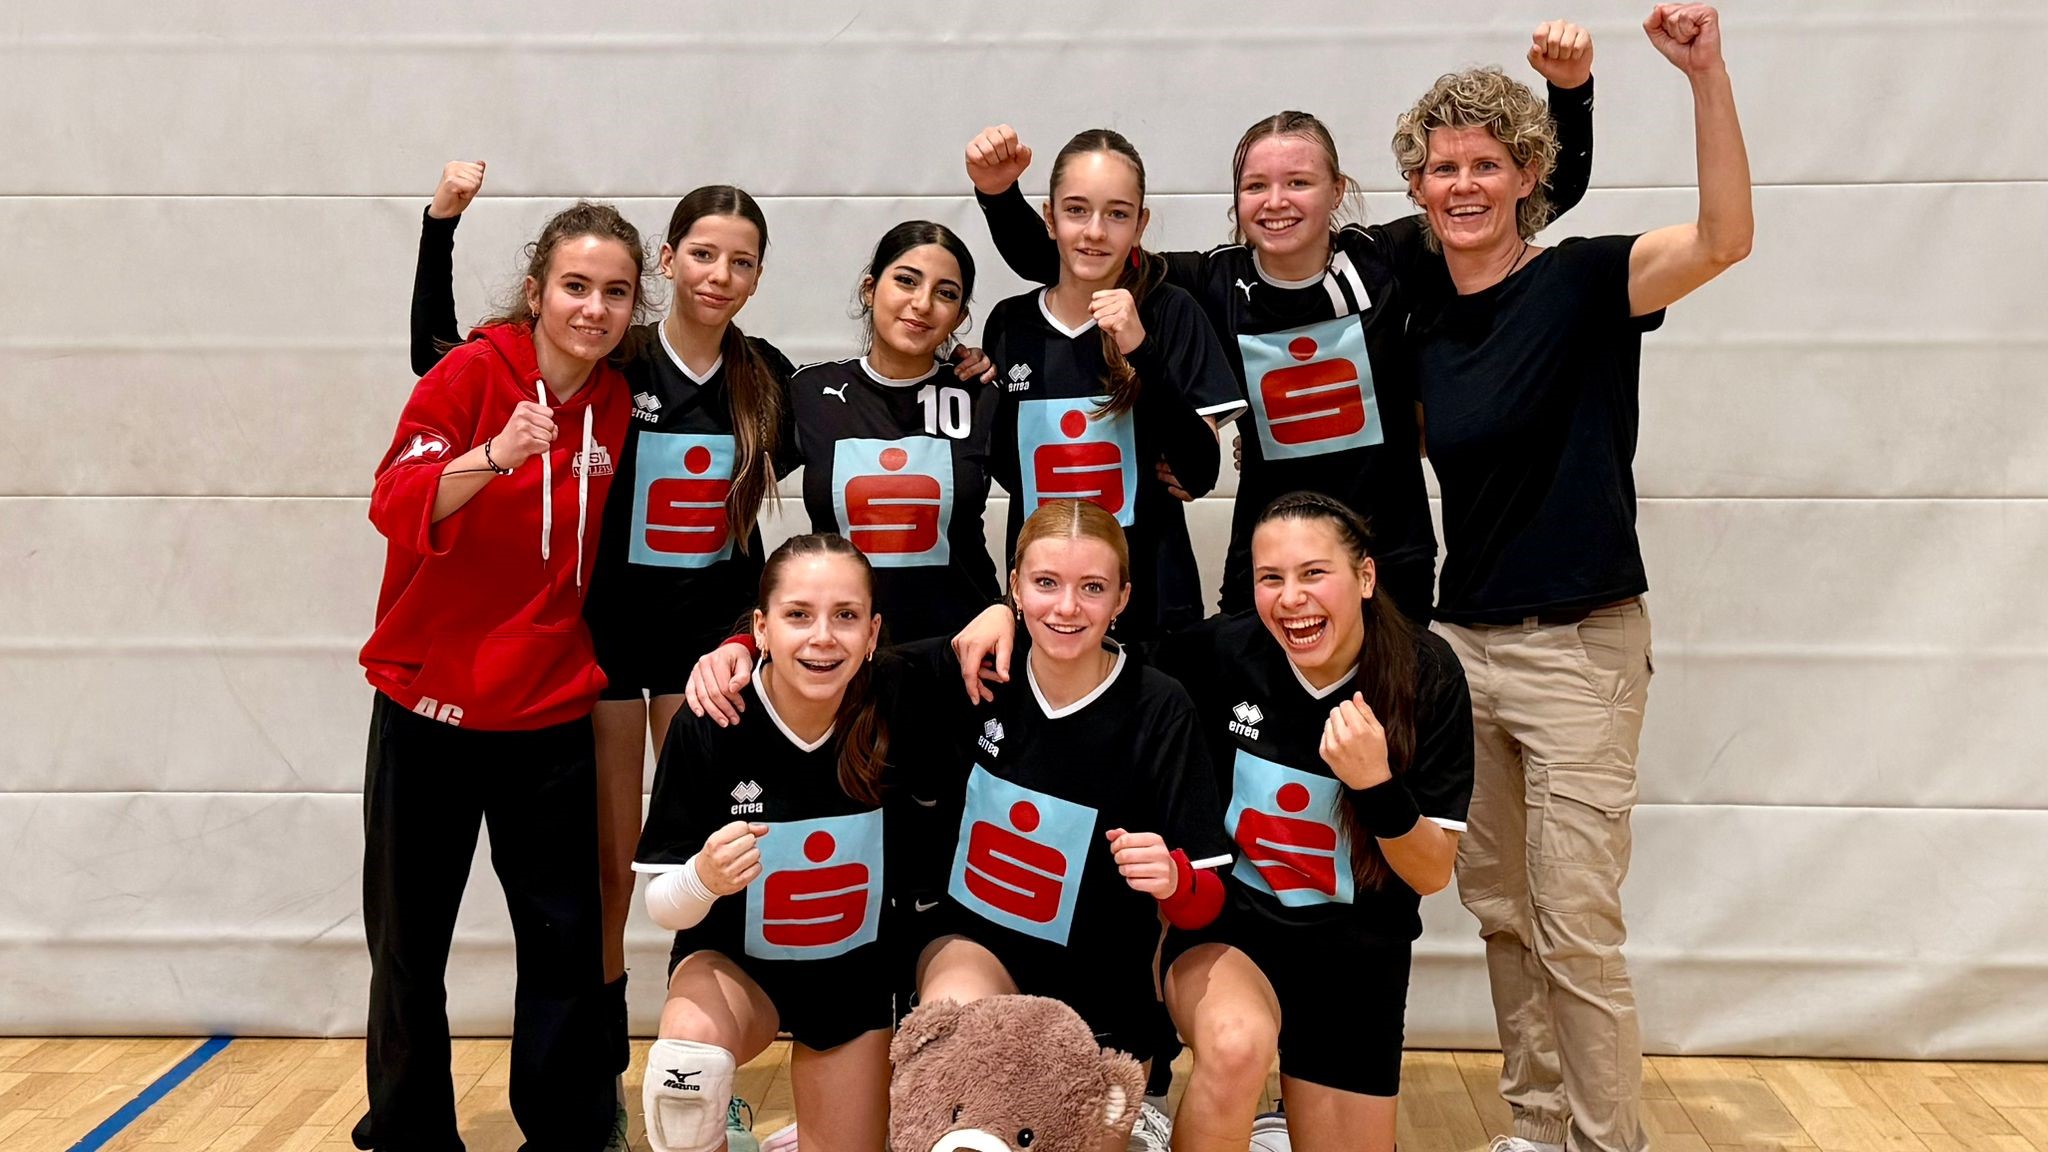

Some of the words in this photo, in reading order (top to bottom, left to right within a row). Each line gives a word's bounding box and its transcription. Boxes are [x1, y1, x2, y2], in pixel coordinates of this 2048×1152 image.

[1322, 249, 1373, 319] 11
[916, 384, 972, 440] 10
[730, 802, 764, 815] errea
